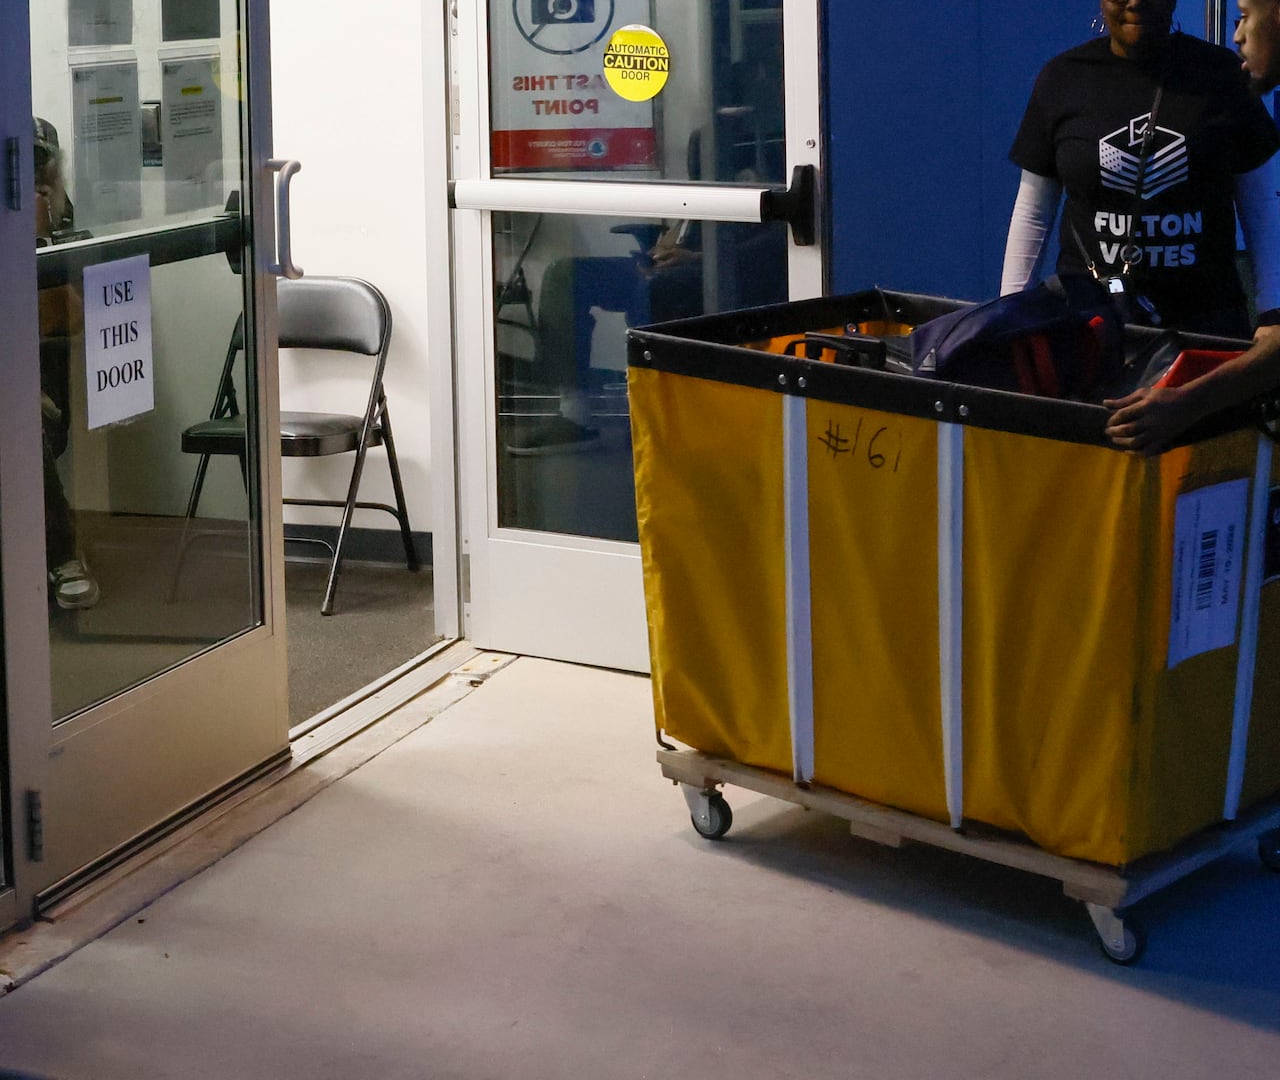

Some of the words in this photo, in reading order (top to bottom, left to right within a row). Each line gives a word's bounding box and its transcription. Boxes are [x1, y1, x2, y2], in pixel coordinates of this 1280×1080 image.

[604, 55, 669, 71] CAUTION
[607, 43, 666, 56] AUTOMATIC
[621, 70, 650, 81] DOOR
[1094, 210, 1203, 238] FULTON
[1099, 240, 1197, 268] VOTES
[102, 279, 134, 307] USE
[99, 320, 139, 351] THIS
[96, 358, 145, 392] DOOR
